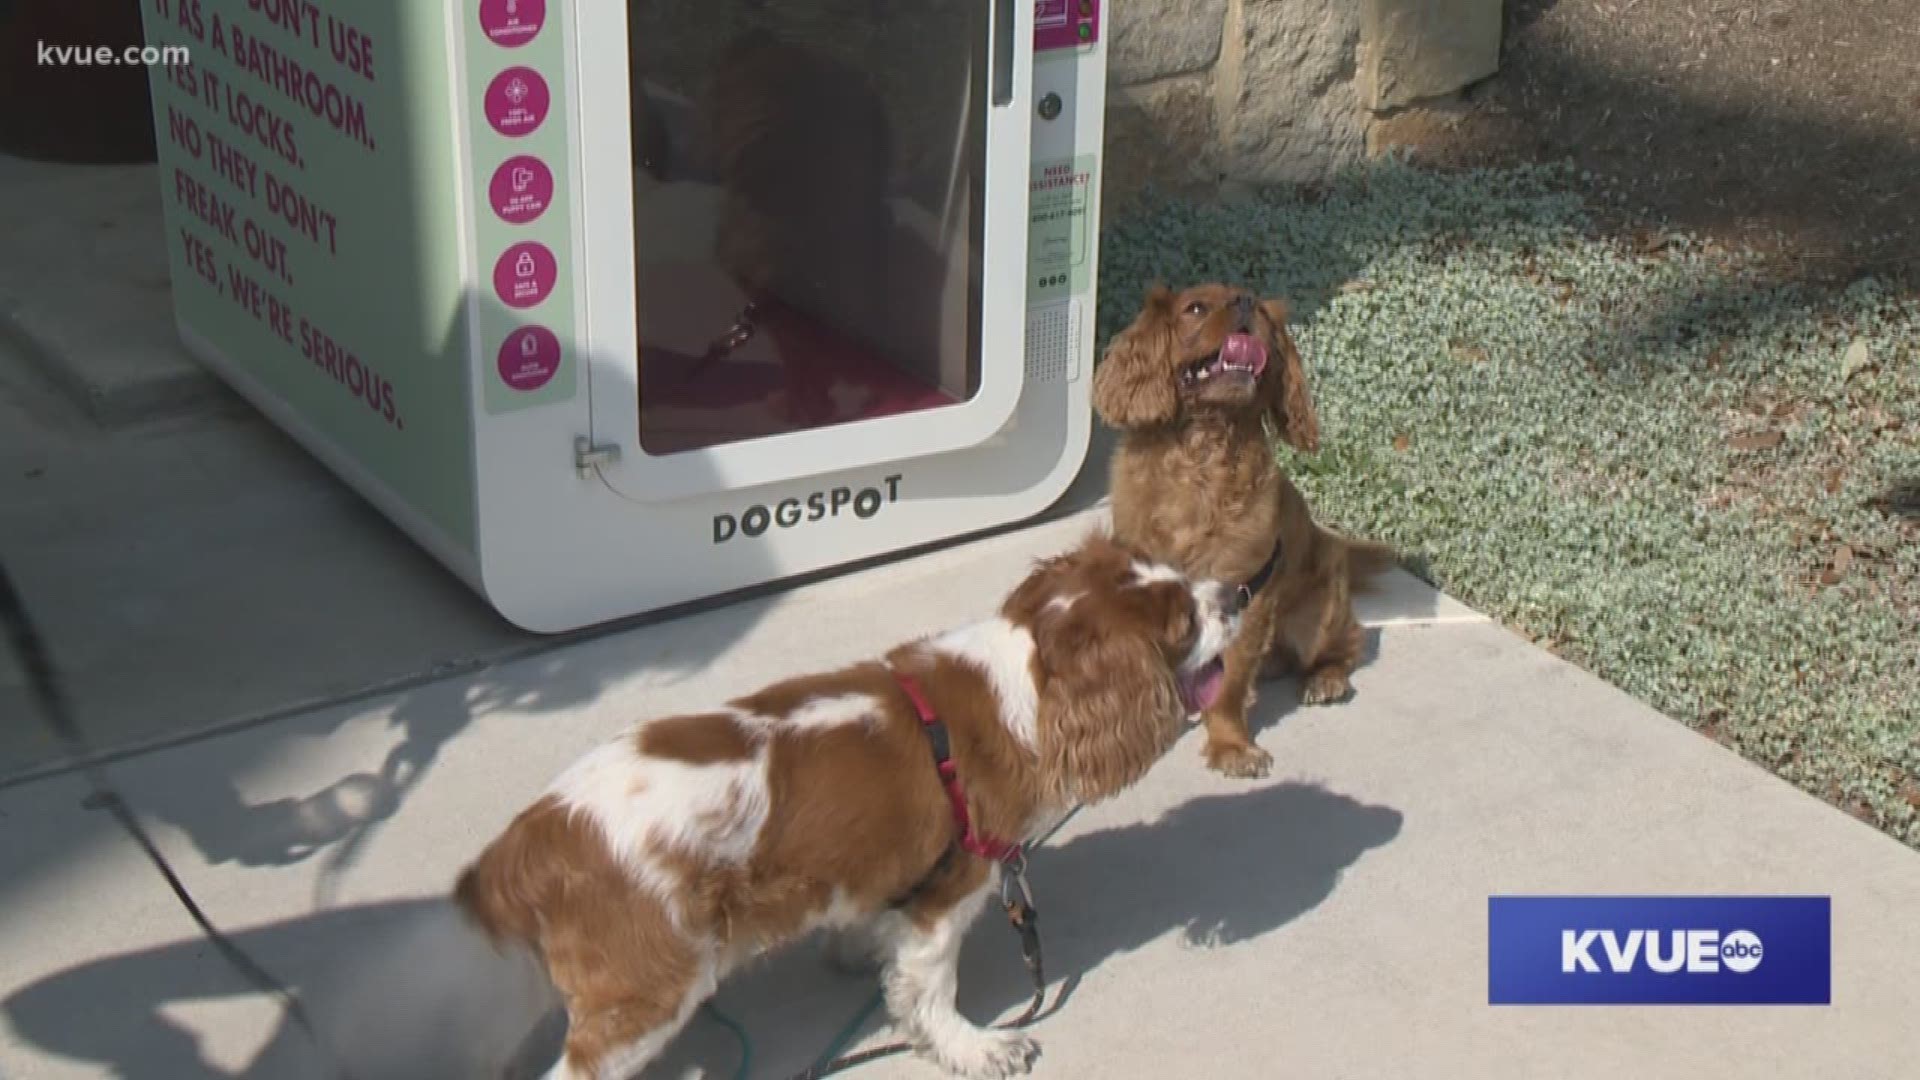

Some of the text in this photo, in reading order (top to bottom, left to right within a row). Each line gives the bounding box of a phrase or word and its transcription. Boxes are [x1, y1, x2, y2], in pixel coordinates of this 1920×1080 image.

[178, 0, 205, 42] AS
[212, 12, 228, 57] A
[231, 24, 375, 151] BATHROOM.
[327, 14, 375, 81] USE
[201, 68, 220, 114] IT
[226, 83, 304, 169] LOCKS.
[168, 103, 337, 255] NO THEY DON'T
[174, 168, 293, 287] FREAK OUT.
[180, 227, 404, 431] YES, WE'RE SERIOUS.
[713, 474, 903, 544] DOGSPOT
